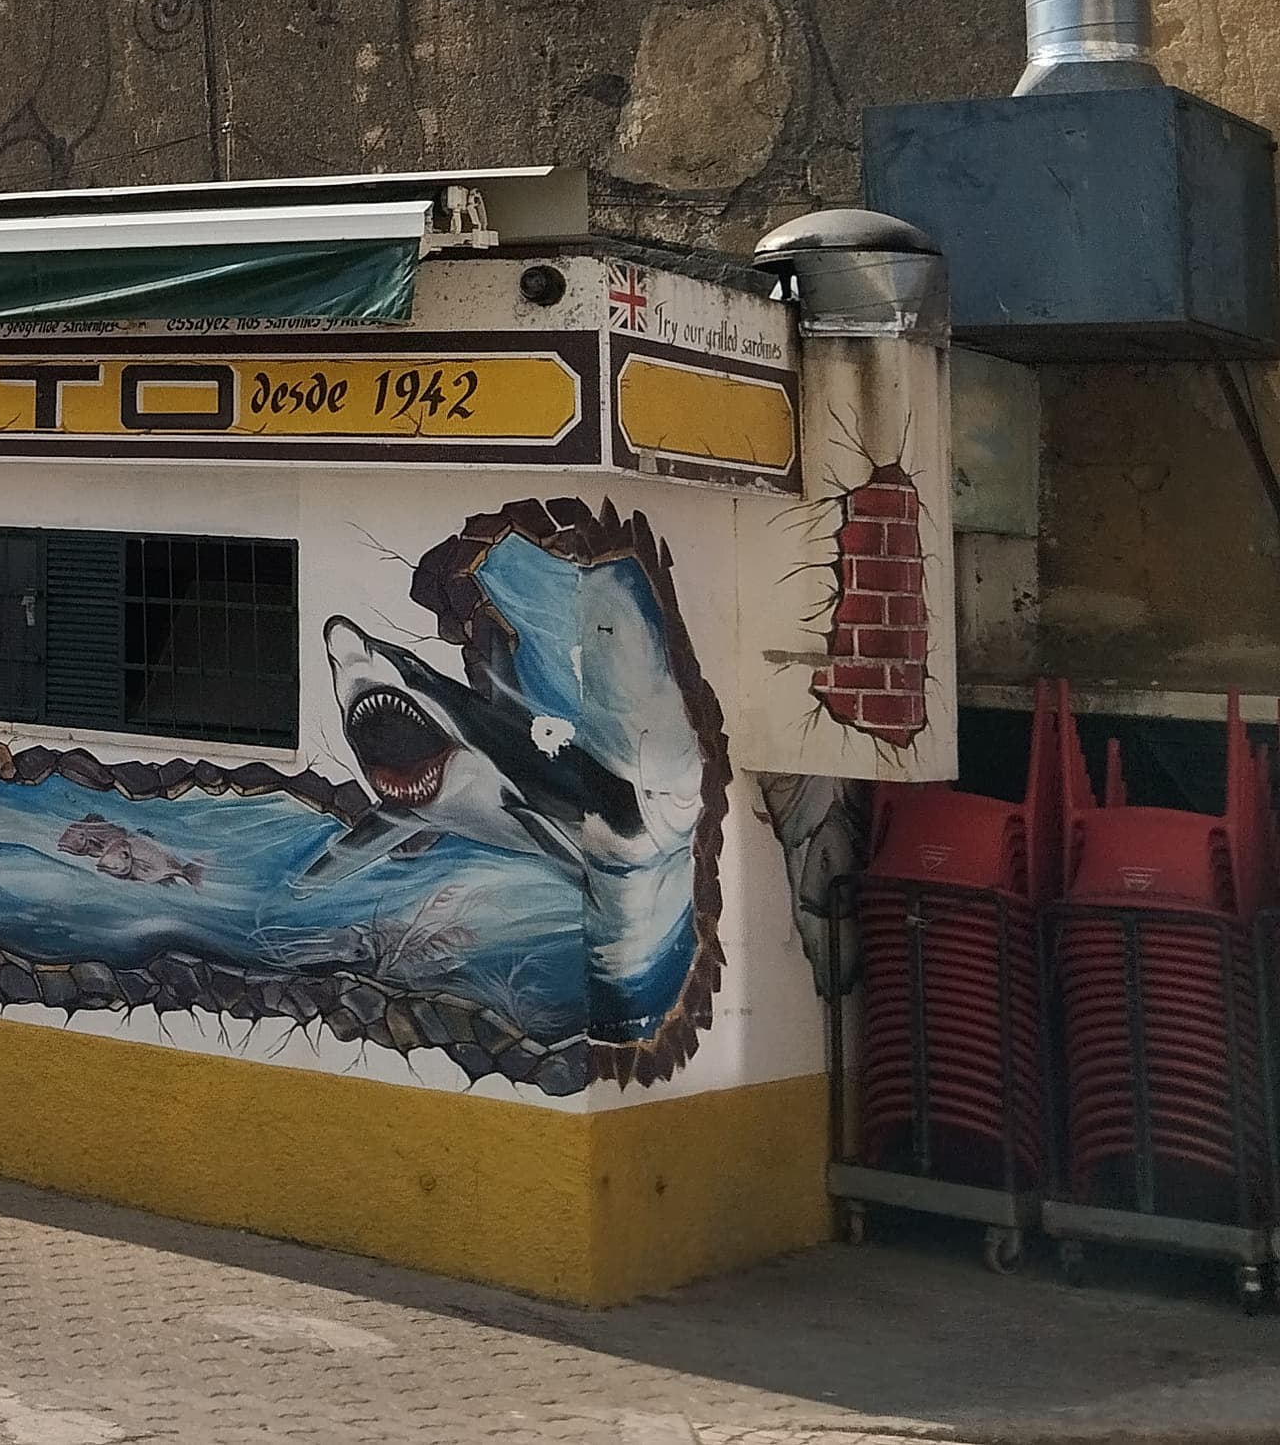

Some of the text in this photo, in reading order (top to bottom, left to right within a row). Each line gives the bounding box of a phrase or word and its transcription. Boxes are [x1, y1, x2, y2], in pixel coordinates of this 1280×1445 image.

[166, 317, 230, 335] essayez
[654, 300, 782, 360] Try our grilled sardines
[250, 369, 479, 421] desde 1942
